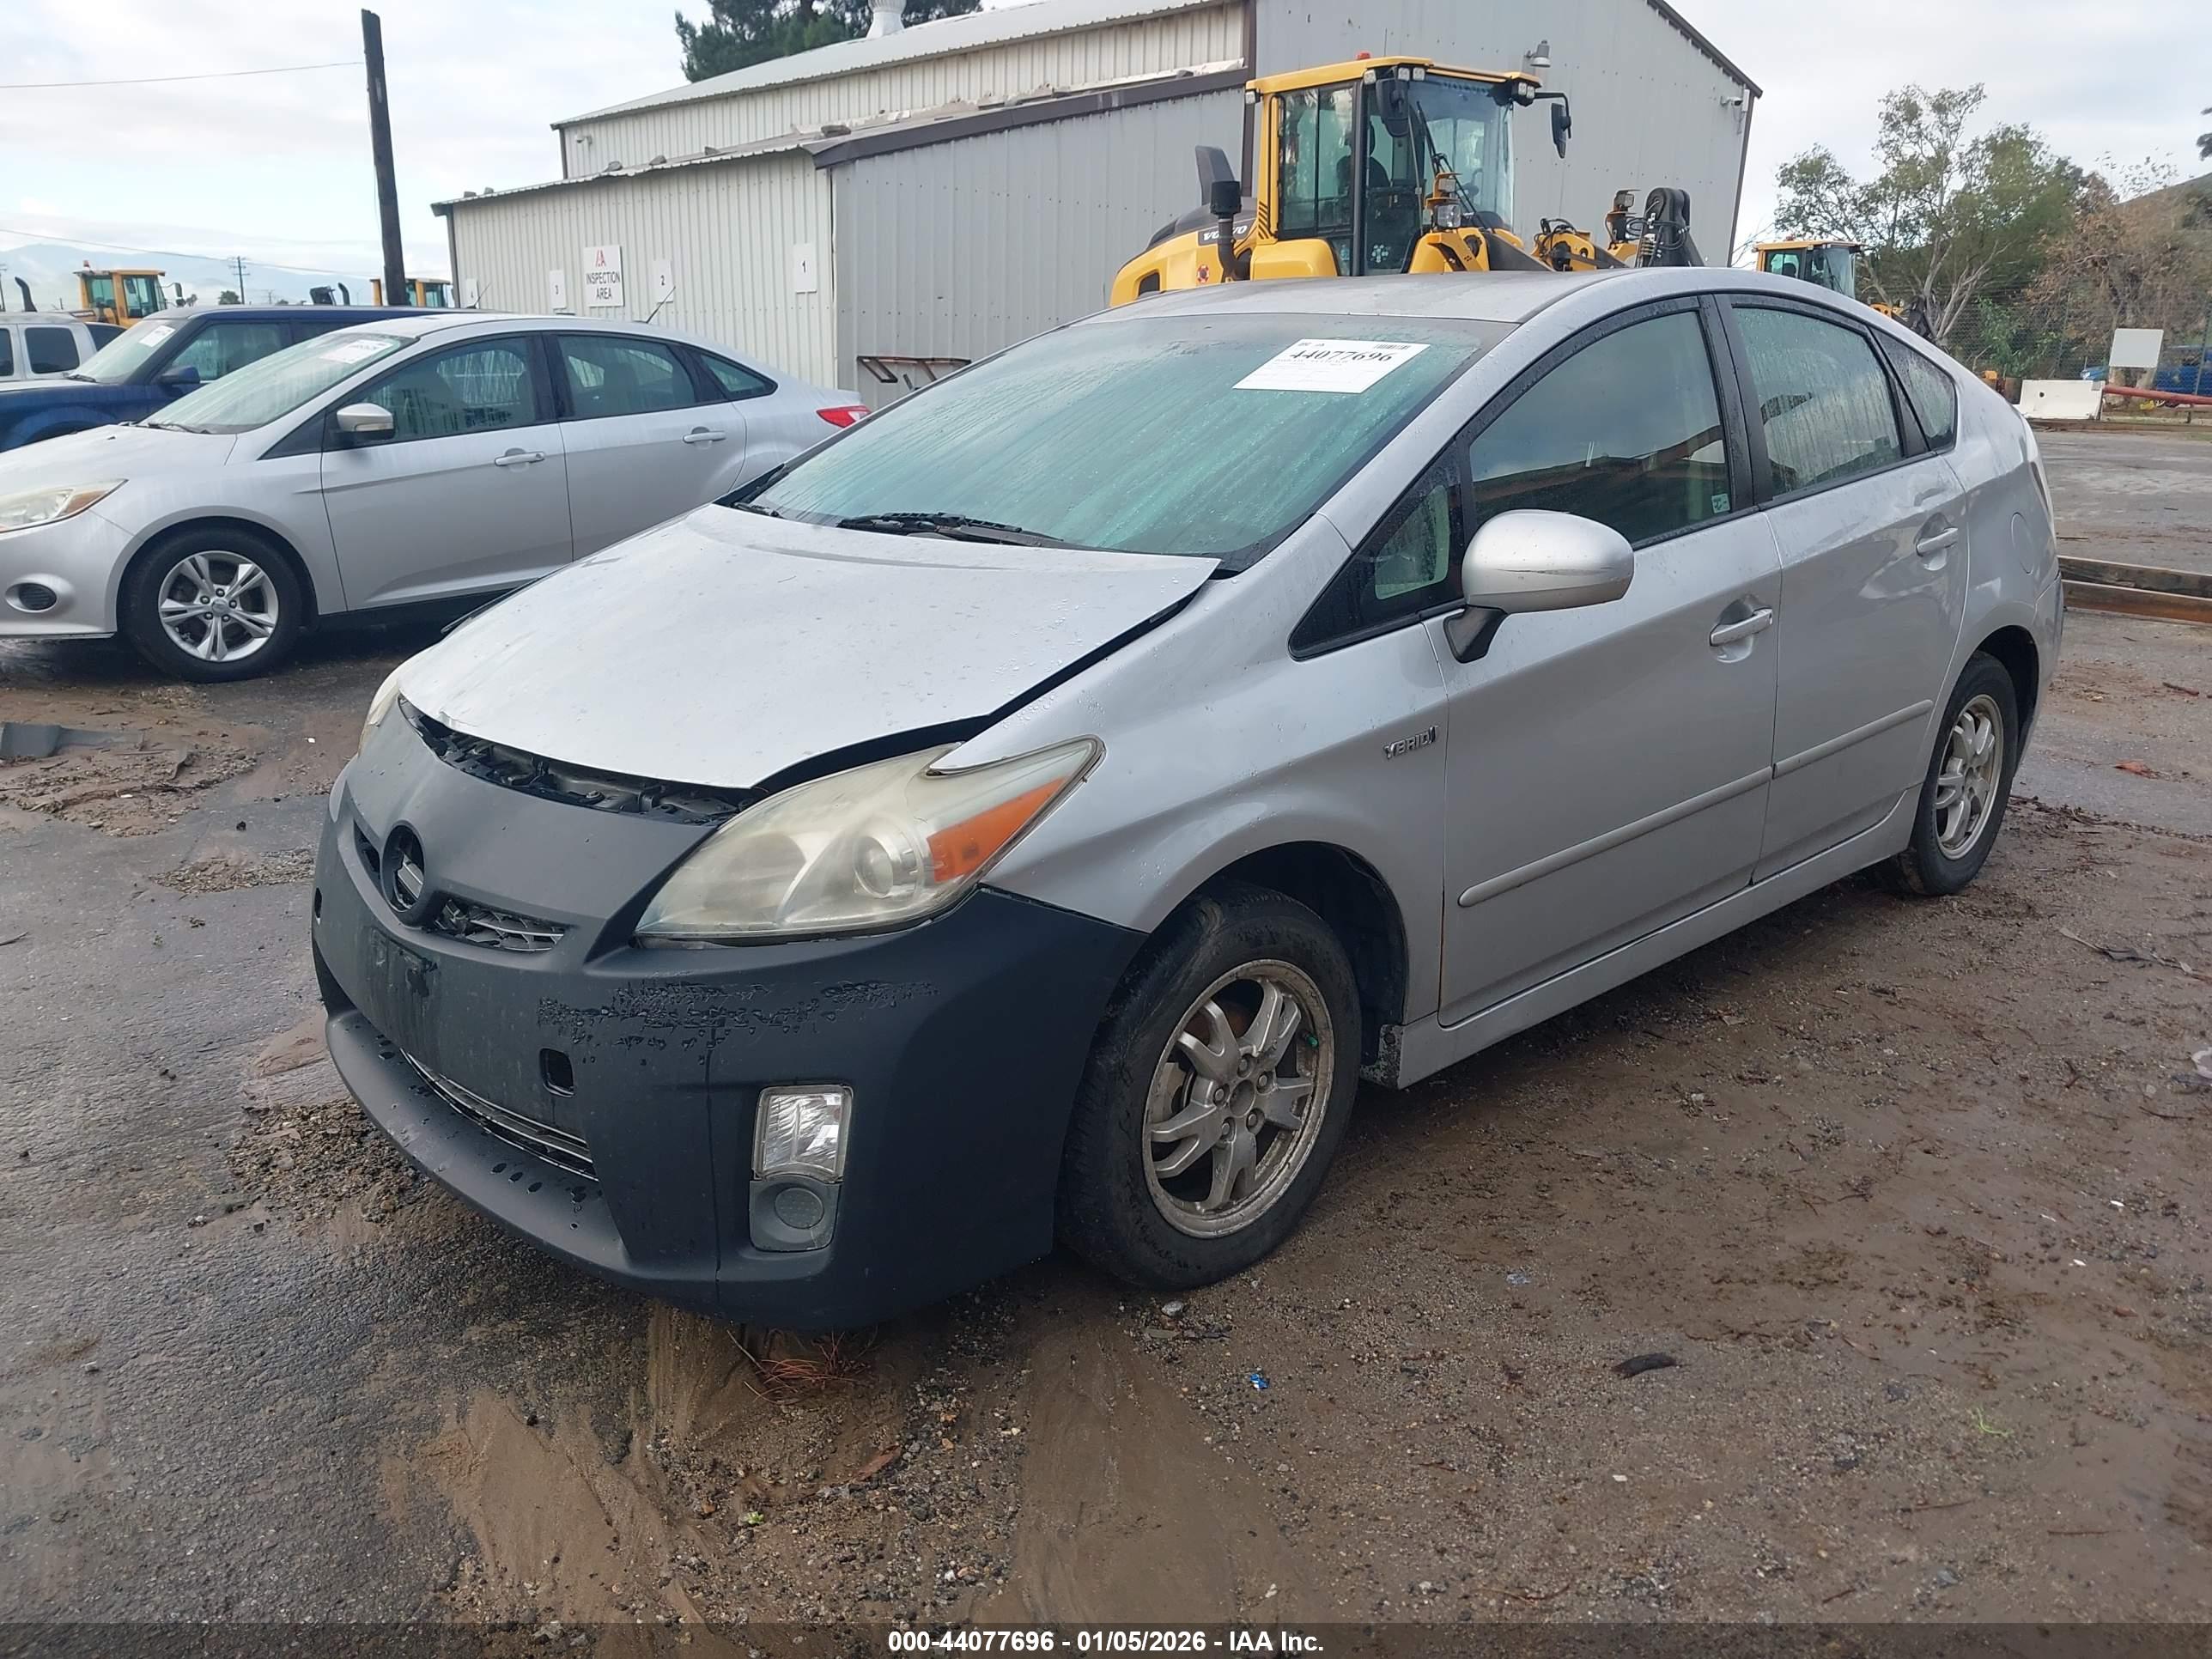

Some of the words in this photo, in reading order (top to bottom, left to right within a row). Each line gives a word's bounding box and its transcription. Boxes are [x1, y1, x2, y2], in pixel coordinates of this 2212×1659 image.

[801, 260, 806, 273] 1
[586, 270, 621, 285] INSPECTION
[660, 275, 665, 286] 2
[596, 287, 612, 301] AREA
[1289, 349, 1396, 362] 44077696
